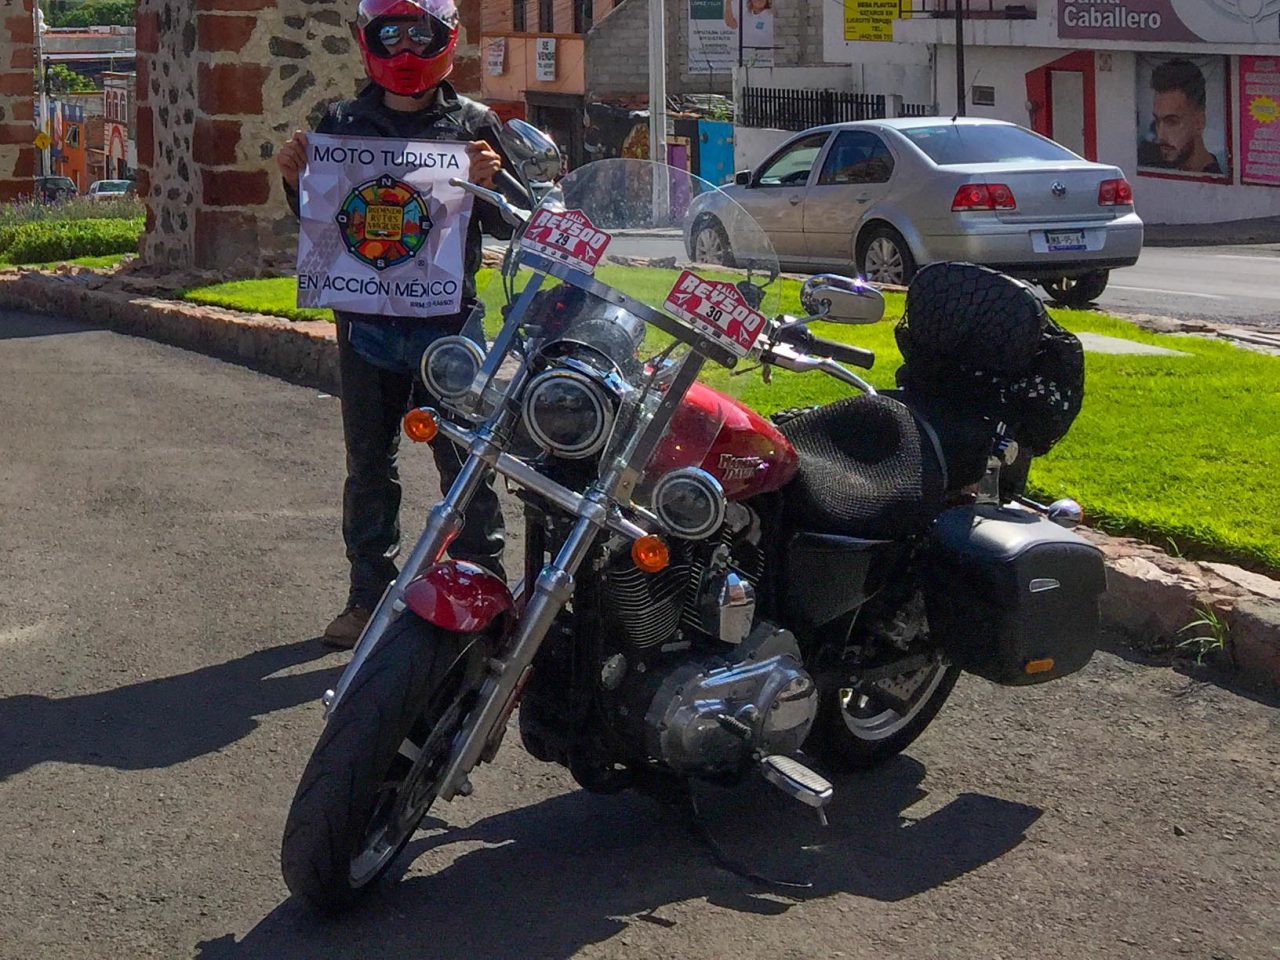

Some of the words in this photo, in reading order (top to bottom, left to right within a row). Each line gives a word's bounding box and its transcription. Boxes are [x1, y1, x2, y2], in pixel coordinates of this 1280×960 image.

[1063, 6, 1161, 29] Caballero
[314, 145, 375, 166] MOTO
[381, 150, 460, 170] TURISTA
[381, 177, 392, 187] N
[535, 210, 607, 250] REY500
[555, 232, 570, 246] 29
[298, 274, 319, 290] EN
[322, 276, 391, 297] ACCIÓN
[715, 283, 739, 300] RALLY
[679, 274, 761, 332] REY500
[705, 305, 723, 322] 30
